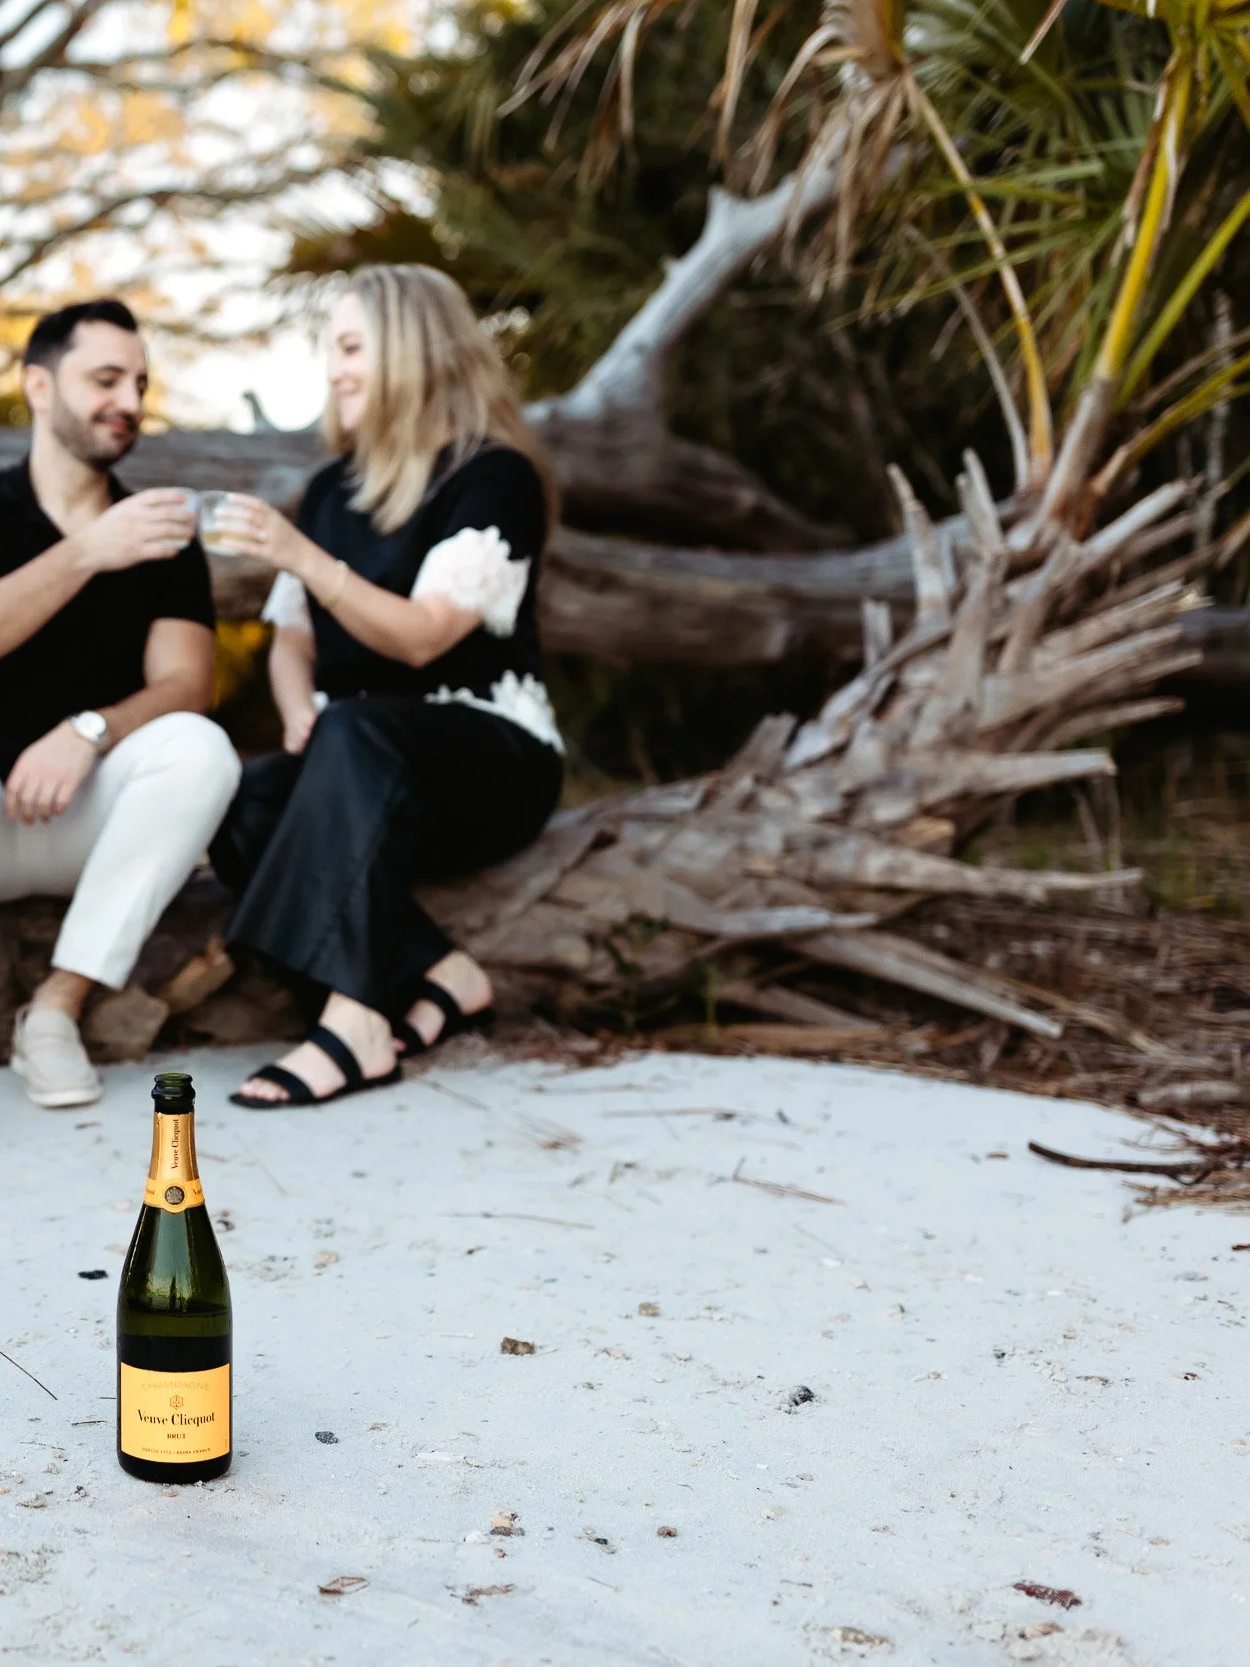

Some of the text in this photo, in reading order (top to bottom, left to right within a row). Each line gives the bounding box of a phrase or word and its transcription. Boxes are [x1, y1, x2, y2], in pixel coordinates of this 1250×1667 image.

[141, 1381, 210, 1391] CHAMPAGNE
[138, 1409, 215, 1427] Veuve Clicquot
